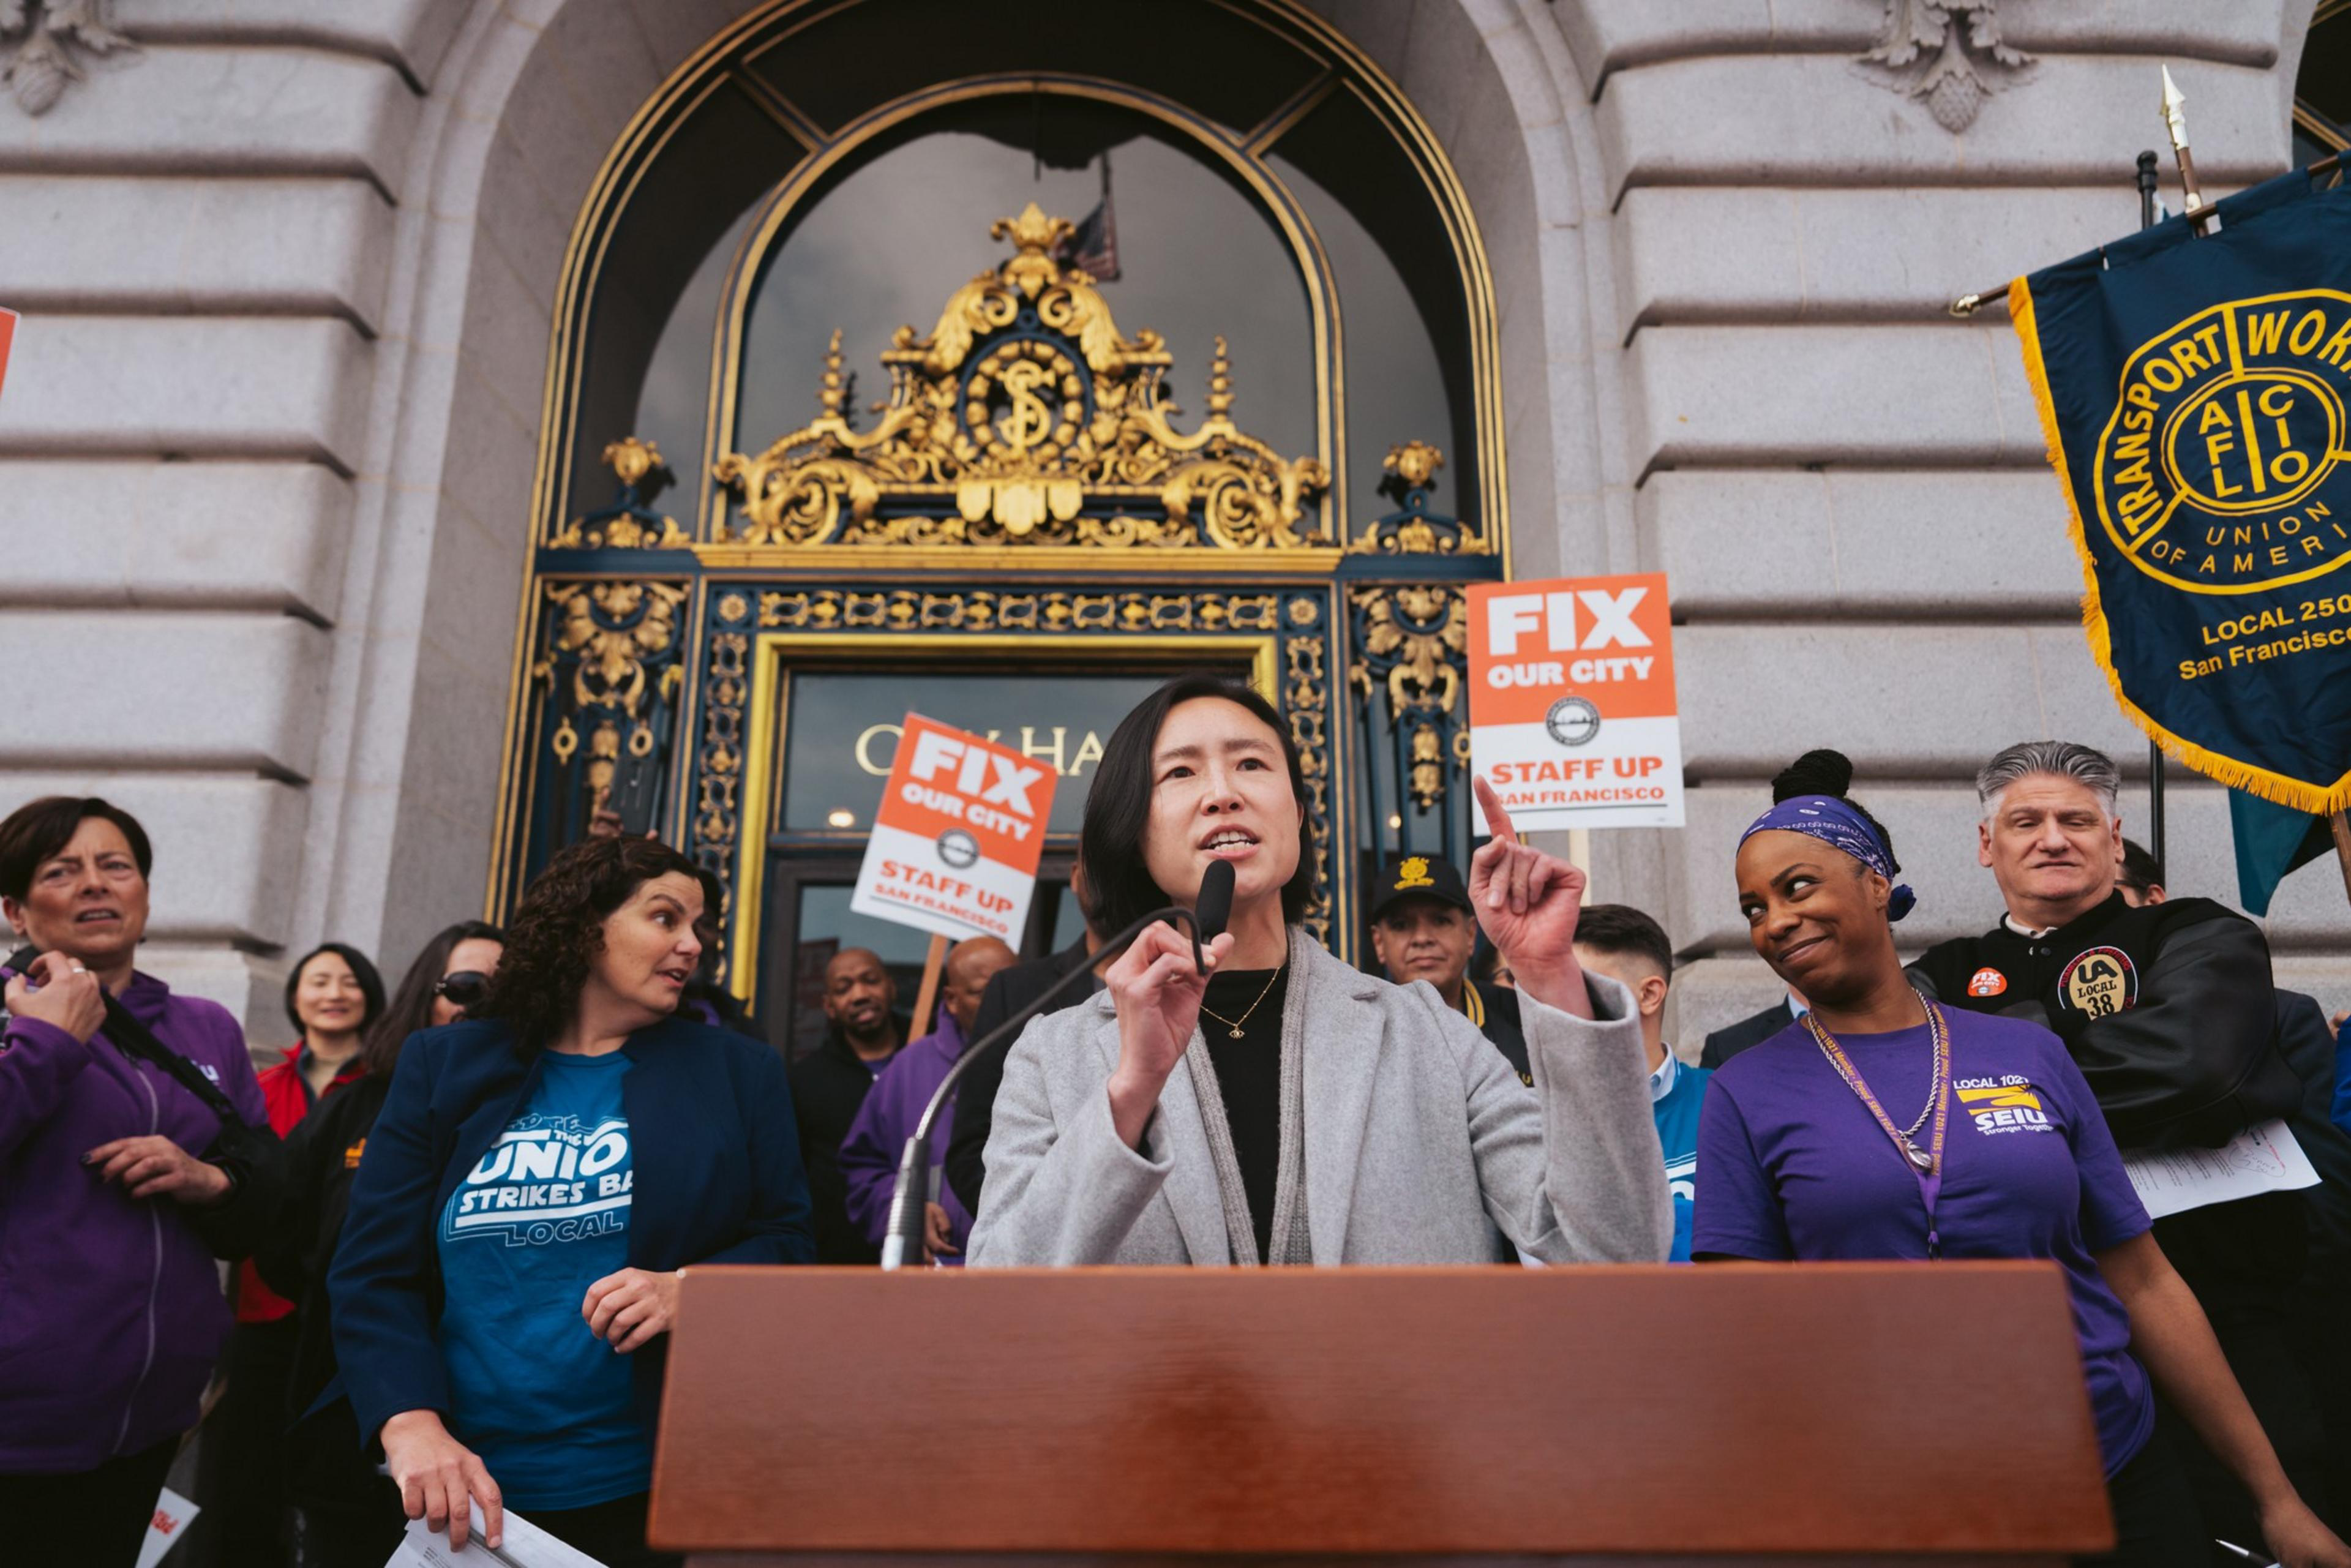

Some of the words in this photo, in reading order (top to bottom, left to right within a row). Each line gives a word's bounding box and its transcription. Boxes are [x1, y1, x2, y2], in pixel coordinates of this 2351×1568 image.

[2113, 323, 2222, 536] TRANSPORT
[2207, 501, 2331, 546] UNION
[2151, 540, 2186, 565] OF
[1487, 587, 1653, 656] FIX
[2202, 607, 2295, 645] LOCAL
[1487, 661, 1565, 689] OUR
[1570, 656, 1654, 684] CITY
[2178, 655, 2223, 680] San
[909, 729, 1043, 819] FIX
[1491, 758, 1605, 785] STAFF
[1613, 756, 1664, 779] UP
[1500, 792, 1534, 805] AN
[1540, 787, 1665, 803] FRANCISCO
[901, 782, 964, 819] OUR
[967, 803, 1033, 841] CITY
[881, 860, 973, 899] STAFF
[977, 889, 1014, 913] UP
[875, 883, 909, 901] SAN
[914, 895, 1008, 934] FRANCISCO
[1972, 972, 2001, 984] FIX
[2078, 959, 2118, 984] UA
[2077, 980, 2117, 999] LOCAL
[2087, 993, 2115, 1017] 38
[1940, 1040, 1949, 1057] SEIU
[1940, 1059, 1949, 1079] Proud
[1953, 1077, 1997, 1089] LOCAL
[1854, 1079, 1872, 1100] Proud
[1868, 1100, 1885, 1118] SEIU
[1935, 1112, 1945, 1131] 1021
[1975, 1108, 2048, 1131] SEIU
[1984, 1125, 2022, 1136] Stronger
[1934, 1133, 1944, 1150] SEIU
[467, 1132, 628, 1185] UNIO
[460, 1182, 586, 1214] STRIKES
[599, 1170, 633, 1197] BA
[505, 1211, 623, 1247] LOCAL
